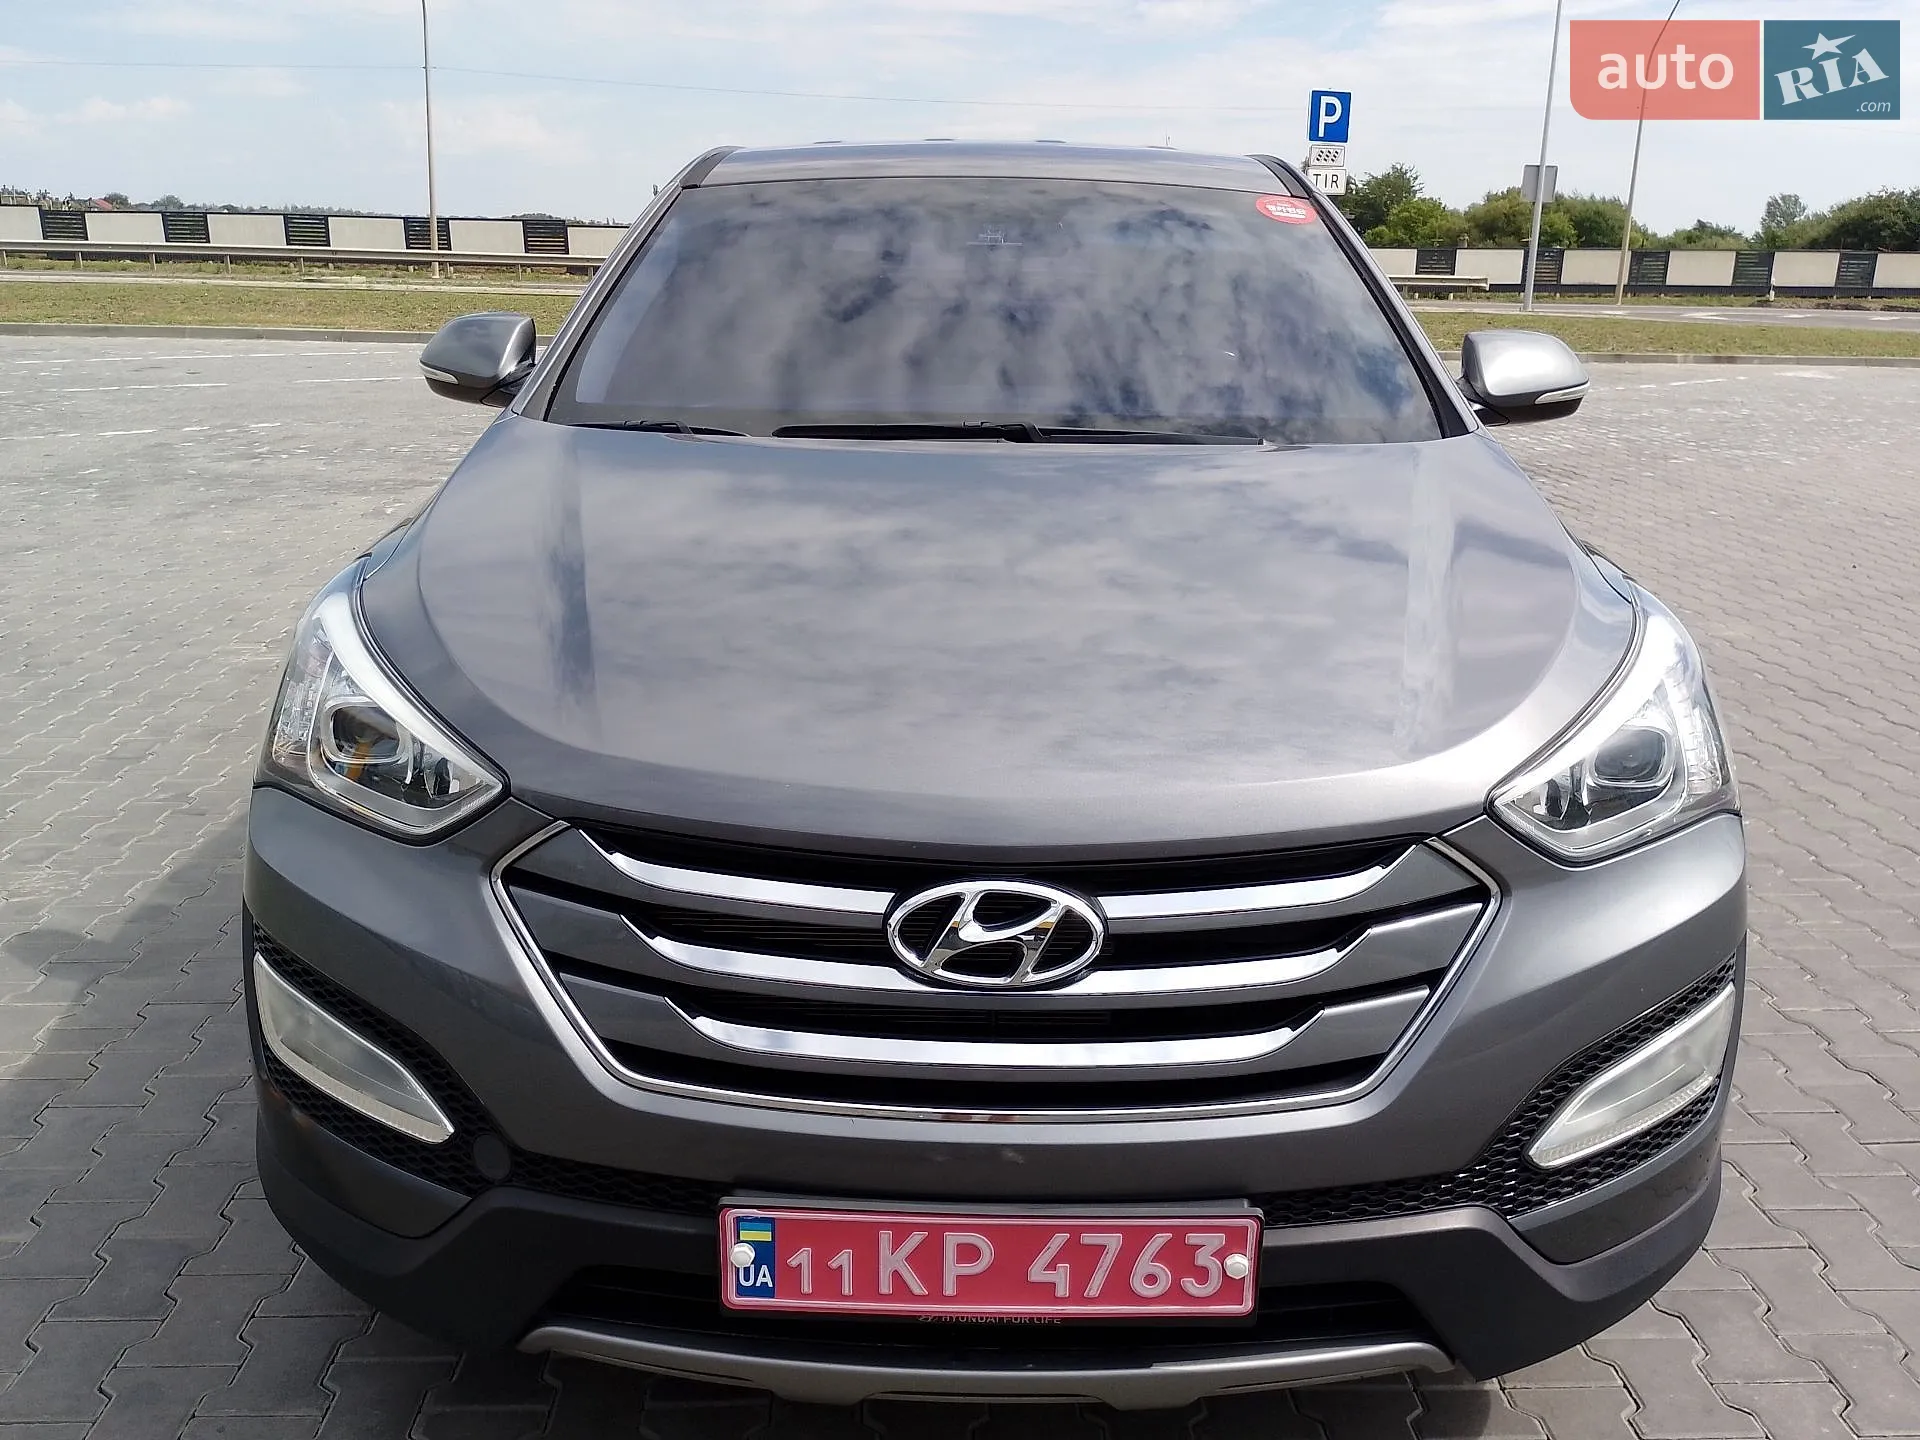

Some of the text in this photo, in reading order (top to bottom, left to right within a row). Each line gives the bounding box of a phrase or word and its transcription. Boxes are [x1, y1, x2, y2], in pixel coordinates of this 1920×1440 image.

[1318, 95, 1342, 138] P
[1313, 173, 1339, 189] TIR
[739, 1266, 773, 1288] UA
[787, 1230, 1226, 1298] 11 KP 4763
